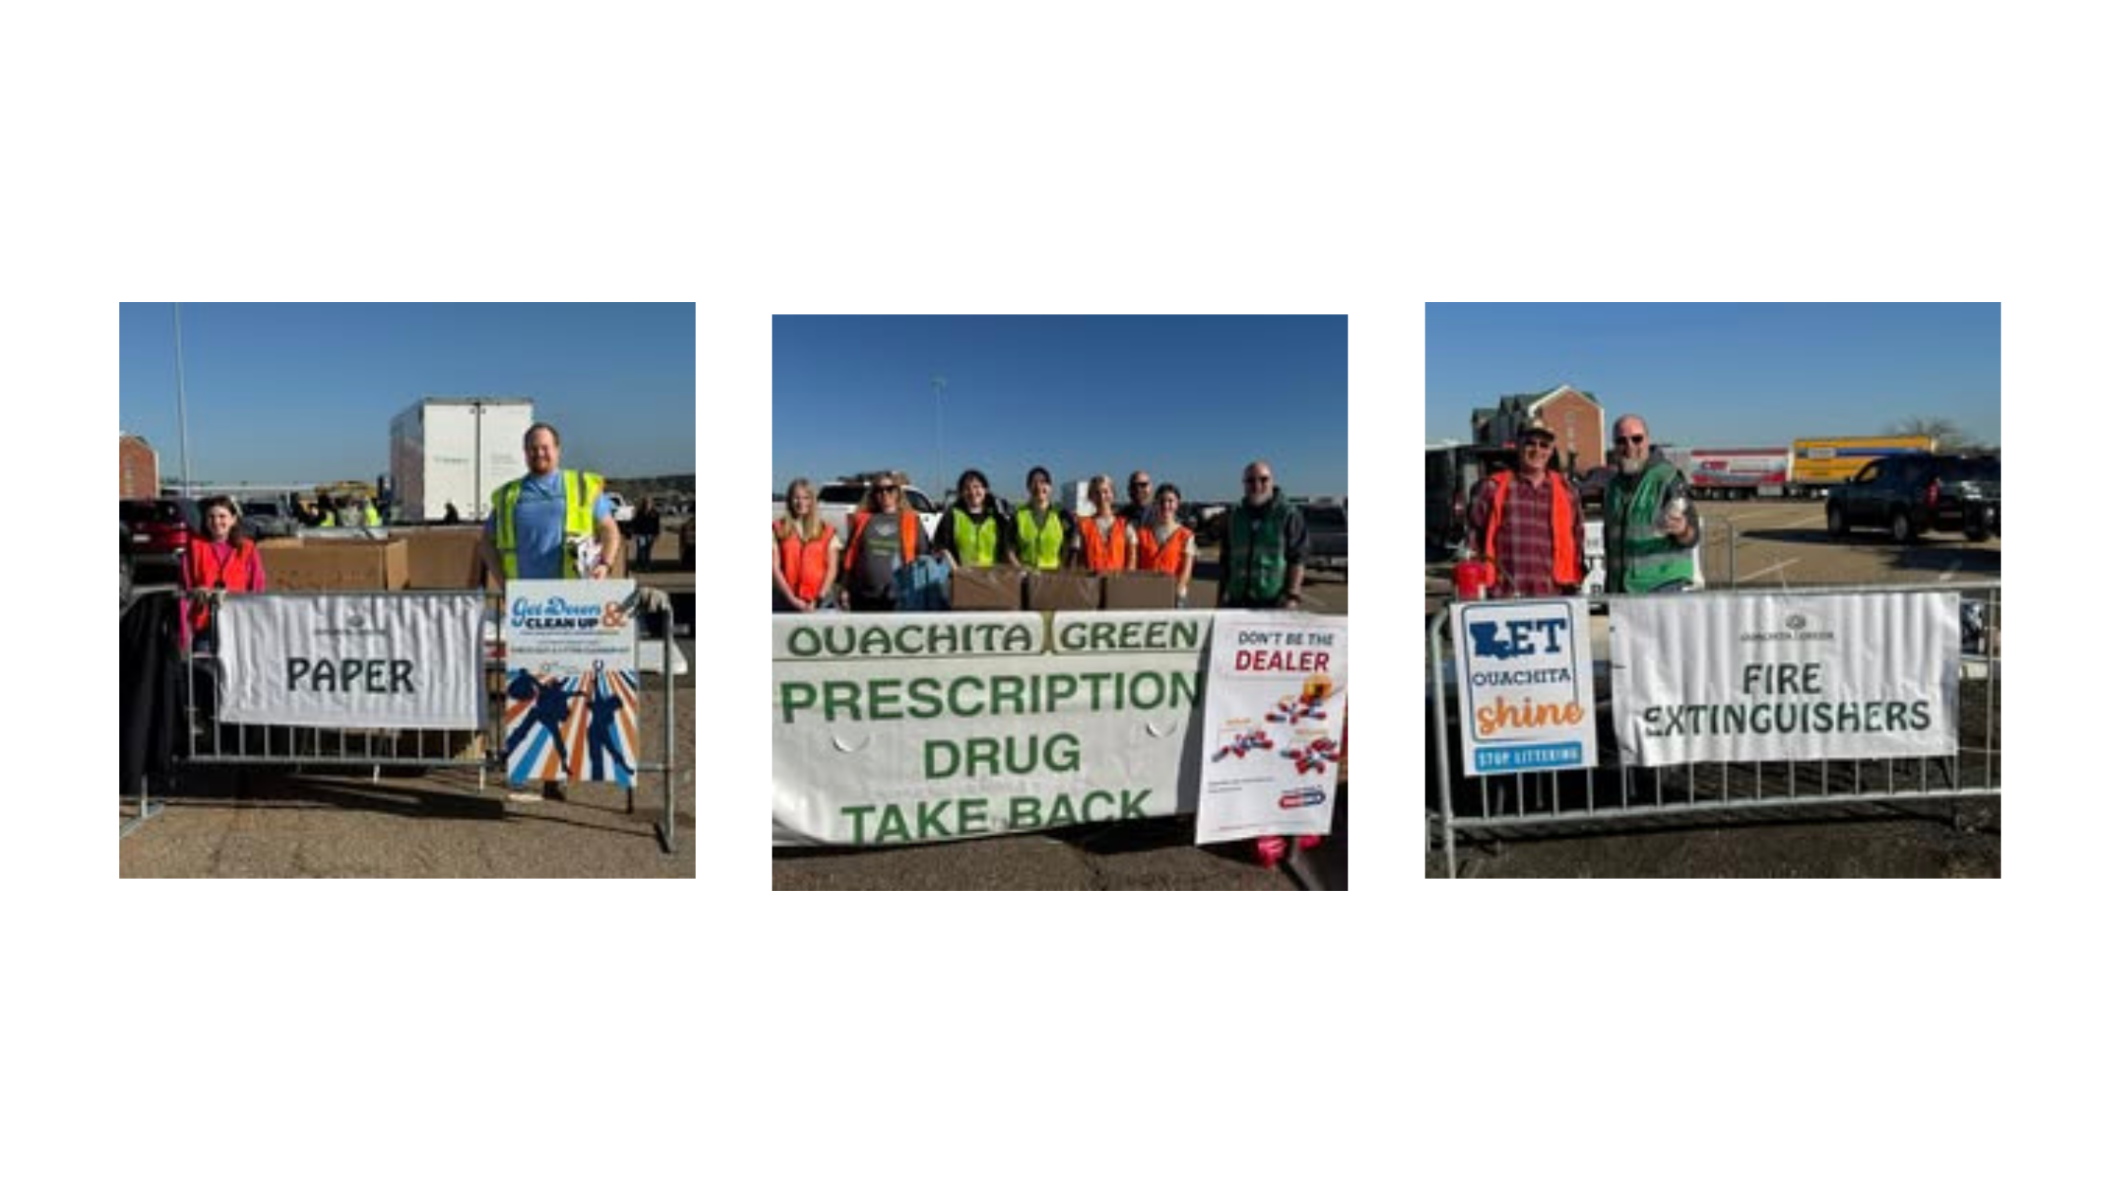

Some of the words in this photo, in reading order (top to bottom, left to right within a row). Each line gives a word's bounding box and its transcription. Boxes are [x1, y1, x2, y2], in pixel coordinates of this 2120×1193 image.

[511, 597, 542, 627] Get
[545, 596, 601, 616] Down
[526, 617, 575, 629] CLEAN
[578, 617, 599, 629] UP
[788, 624, 1032, 656] OUACHITA
[1060, 620, 1198, 649] GREEN
[1238, 631, 1282, 645] DON'T
[1286, 633, 1304, 645] BE
[1308, 633, 1334, 645] THE
[1469, 618, 1567, 659] LET
[287, 657, 415, 693] PAPER
[1235, 650, 1329, 671] DEALER
[1472, 669, 1571, 686] OUACHITA
[1743, 663, 1822, 695] FIRE
[780, 671, 1202, 723] PRESCRIPTION
[1476, 696, 1585, 735] shine
[1644, 701, 1931, 736] EXTINGUISHERS
[924, 733, 1080, 779] DRUG
[1479, 751, 1510, 768] STOP
[842, 799, 989, 844] TAKE
[1009, 789, 1152, 829] BACK
